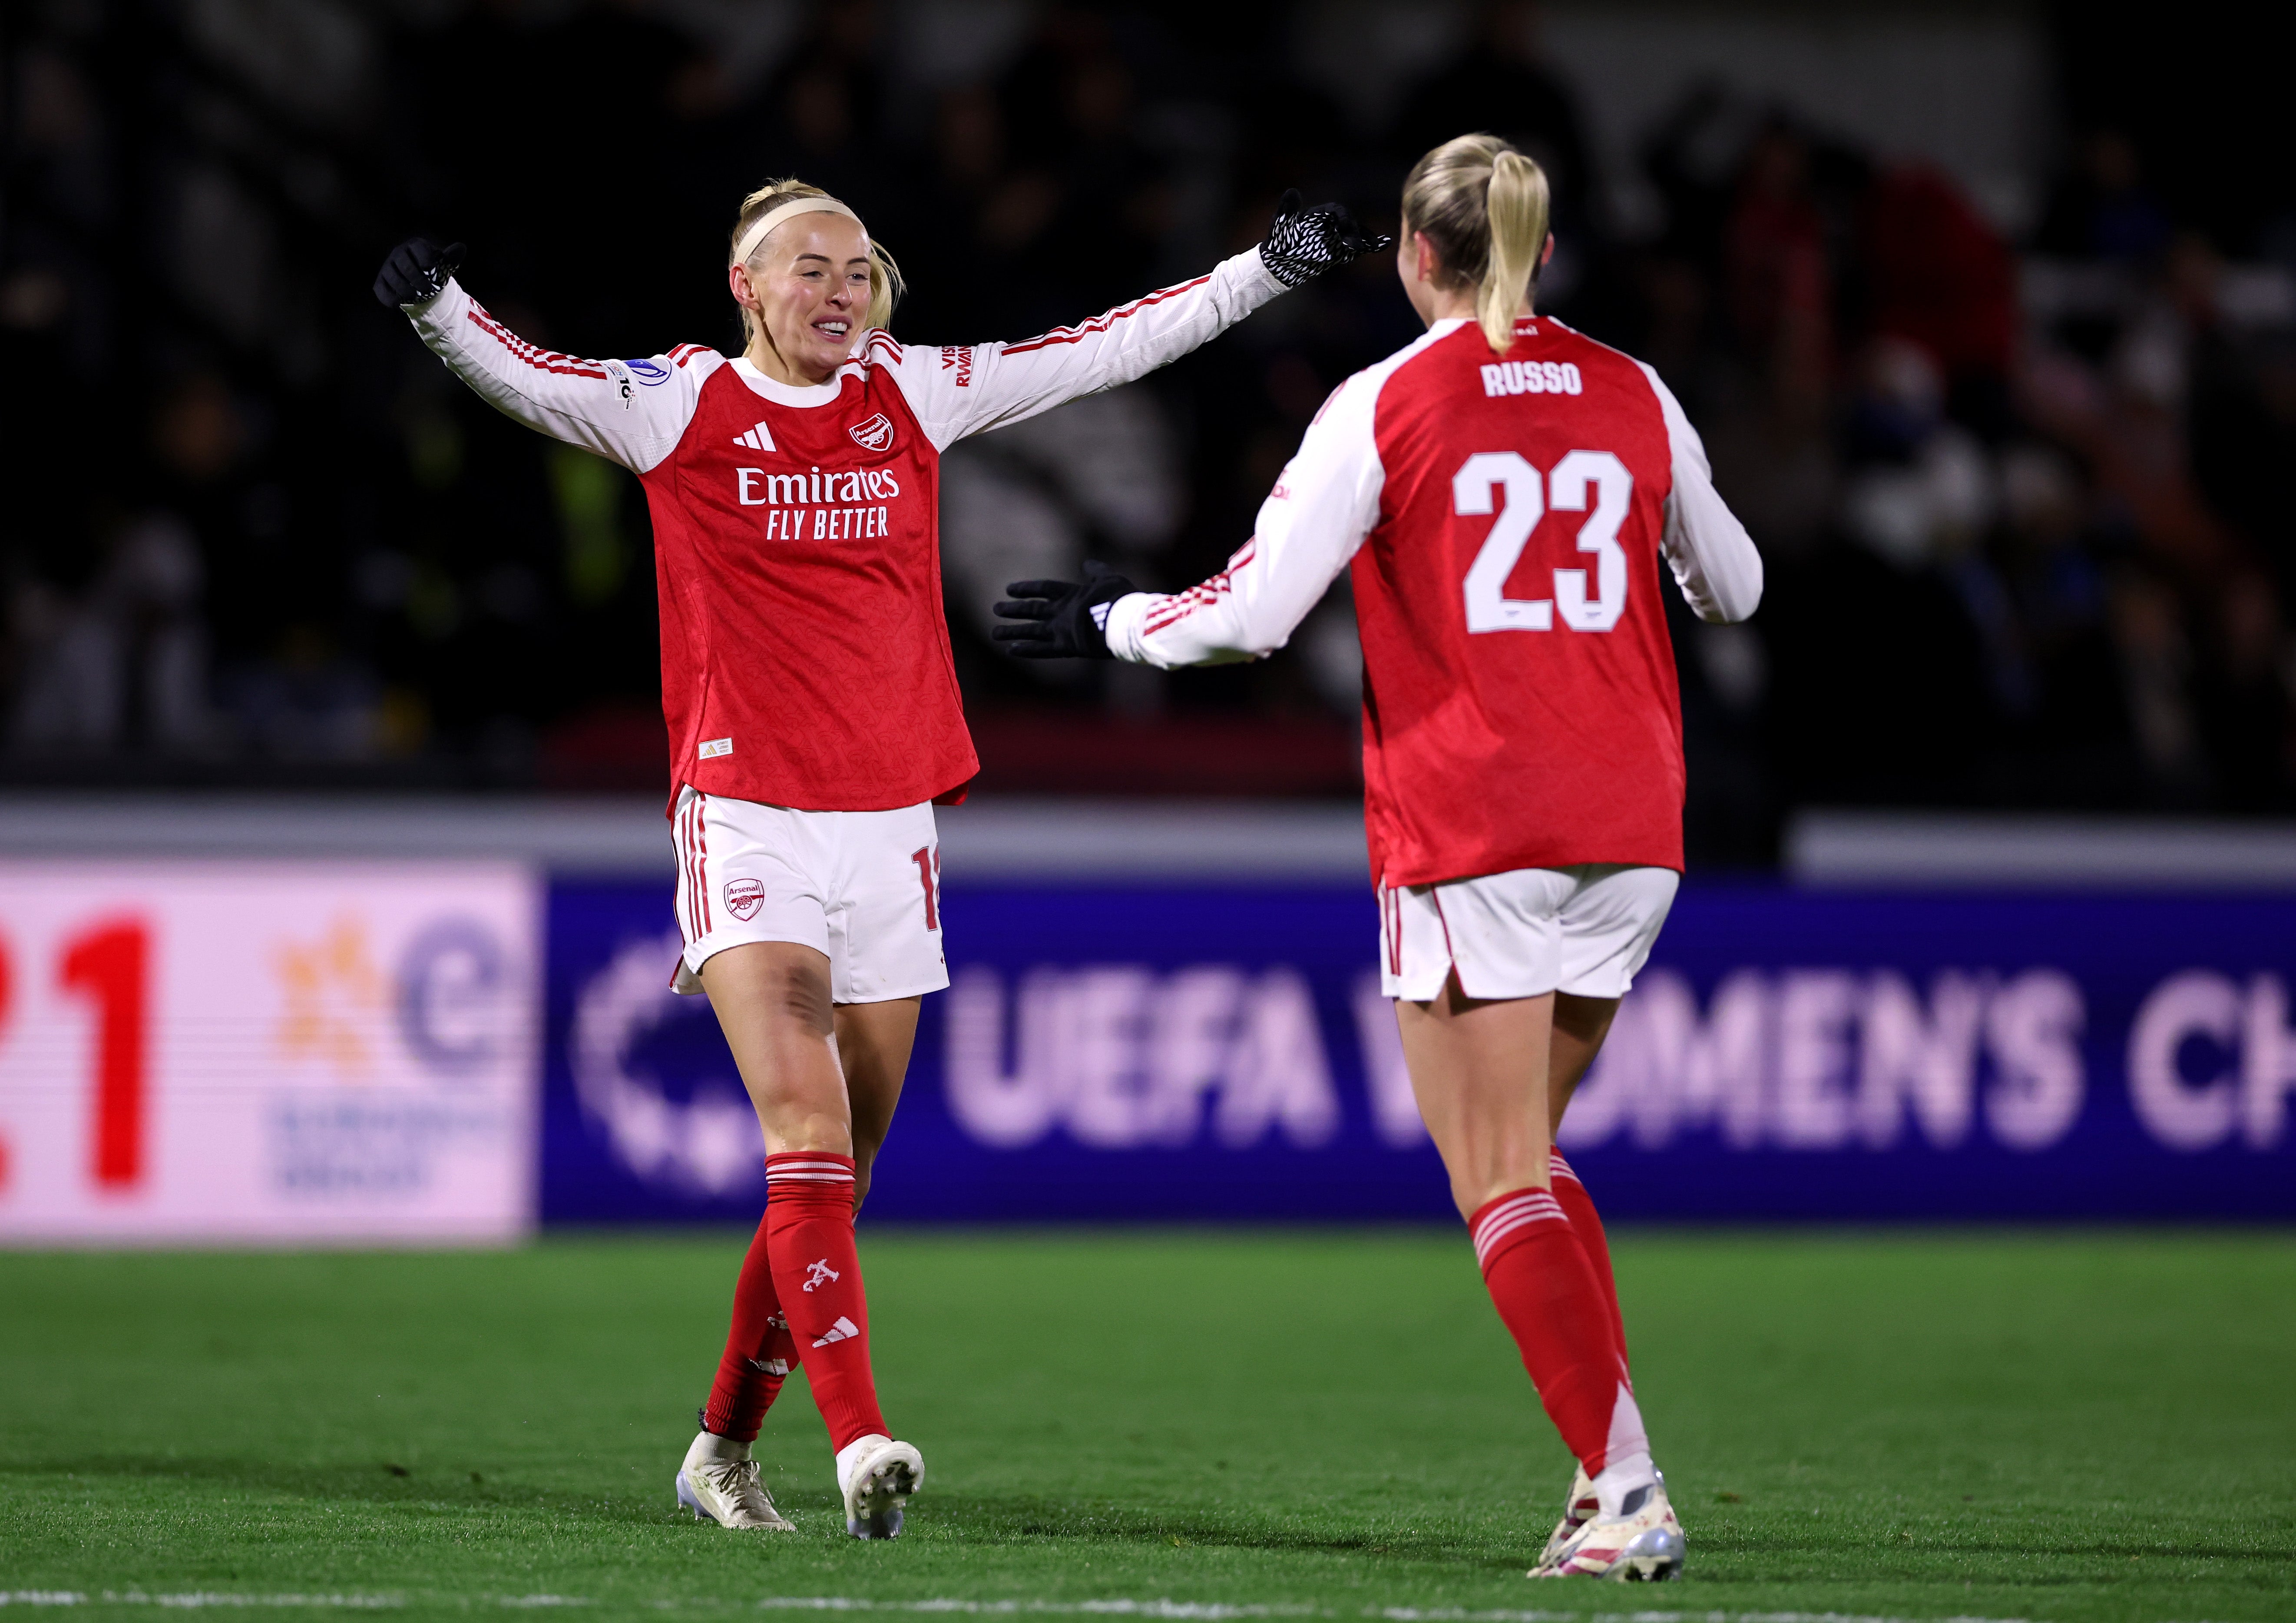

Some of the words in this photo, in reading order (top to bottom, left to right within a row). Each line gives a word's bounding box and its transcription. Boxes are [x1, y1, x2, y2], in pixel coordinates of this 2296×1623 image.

[620, 377, 631, 398] 10
[1480, 361, 1582, 397] RUSSO
[856, 420, 882, 437] Arsenal
[736, 467, 900, 505] Emirates
[767, 510, 806, 540] FLY
[814, 506, 889, 540] BETTER
[1452, 450, 1634, 634] 23
[729, 885, 758, 895] Arsenal
[912, 842, 940, 931] 1
[945, 969, 1338, 1149] UEFA
